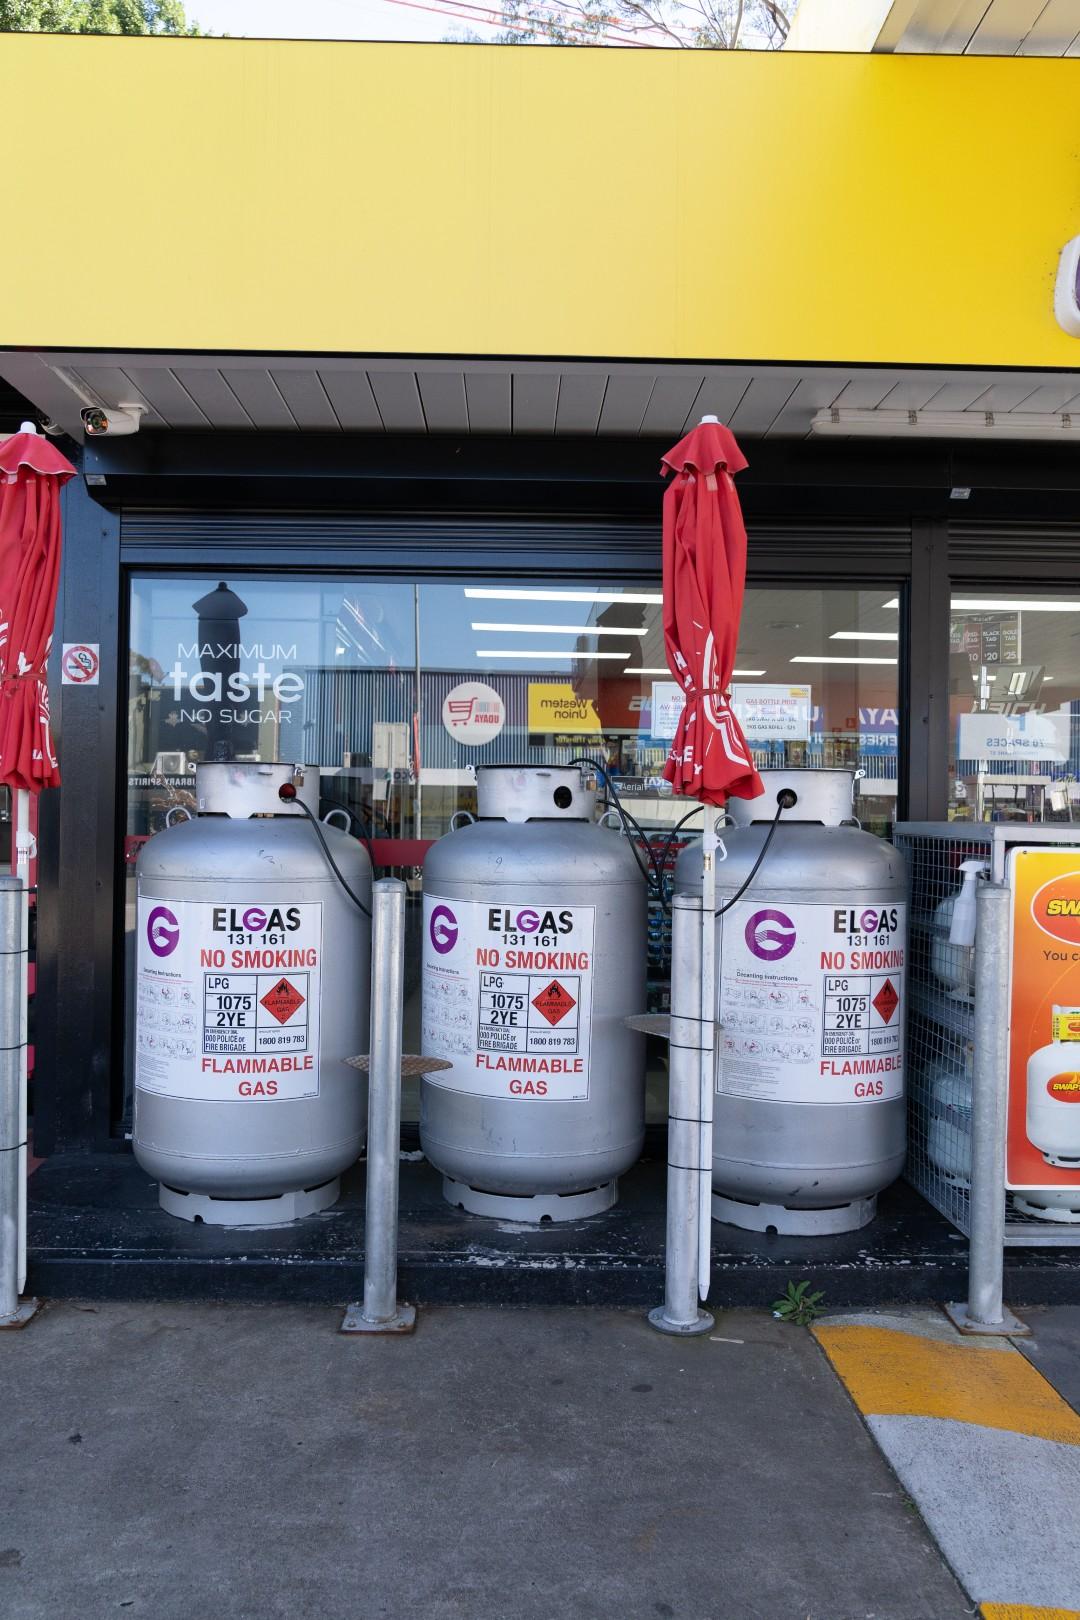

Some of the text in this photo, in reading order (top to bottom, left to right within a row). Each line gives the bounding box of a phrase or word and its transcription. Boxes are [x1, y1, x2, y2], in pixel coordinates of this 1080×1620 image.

[178, 643, 296, 660] MAXIMUM
[169, 662, 304, 703] taste
[180, 709, 292, 724] NO SUGAR
[1047, 899, 1080, 915] SW
[213, 908, 301, 932] ELGAS
[488, 908, 574, 934] ELGAS
[834, 909, 898, 933] ELGAS
[227, 934, 285, 944] 131 161
[502, 934, 558, 947] 131 161
[847, 935, 890, 946] 131 161
[201, 948, 316, 968] NO SMOKING
[476, 948, 589, 970] NO SMOKING
[820, 950, 904, 970] NO SMOKING
[1043, 950, 1080, 961] You c
[208, 978, 229, 990] LPG
[483, 976, 503, 988] LPG
[828, 980, 848, 991] LPG
[217, 996, 251, 1010] 1075
[491, 994, 524, 1009] 1075
[837, 997, 866, 1011] 1075
[217, 1012, 245, 1026] 2YE
[490, 1010, 518, 1026] 2YE
[836, 1014, 862, 1028] 2YE
[217, 1035, 238, 1043] POLICE
[293, 1035, 304, 1043] 783
[490, 1032, 510, 1041] POLICE
[493, 1041, 517, 1050] BRIGADE
[838, 1045, 862, 1053] BRIGADE
[202, 1055, 314, 1074] FLAMMABLE
[476, 1054, 584, 1073] FLAMMABLE
[820, 1055, 902, 1075] FLAMMABLE
[238, 1081, 278, 1096] GAS
[509, 1080, 548, 1095] GAS
[854, 1081, 883, 1097] GAS
